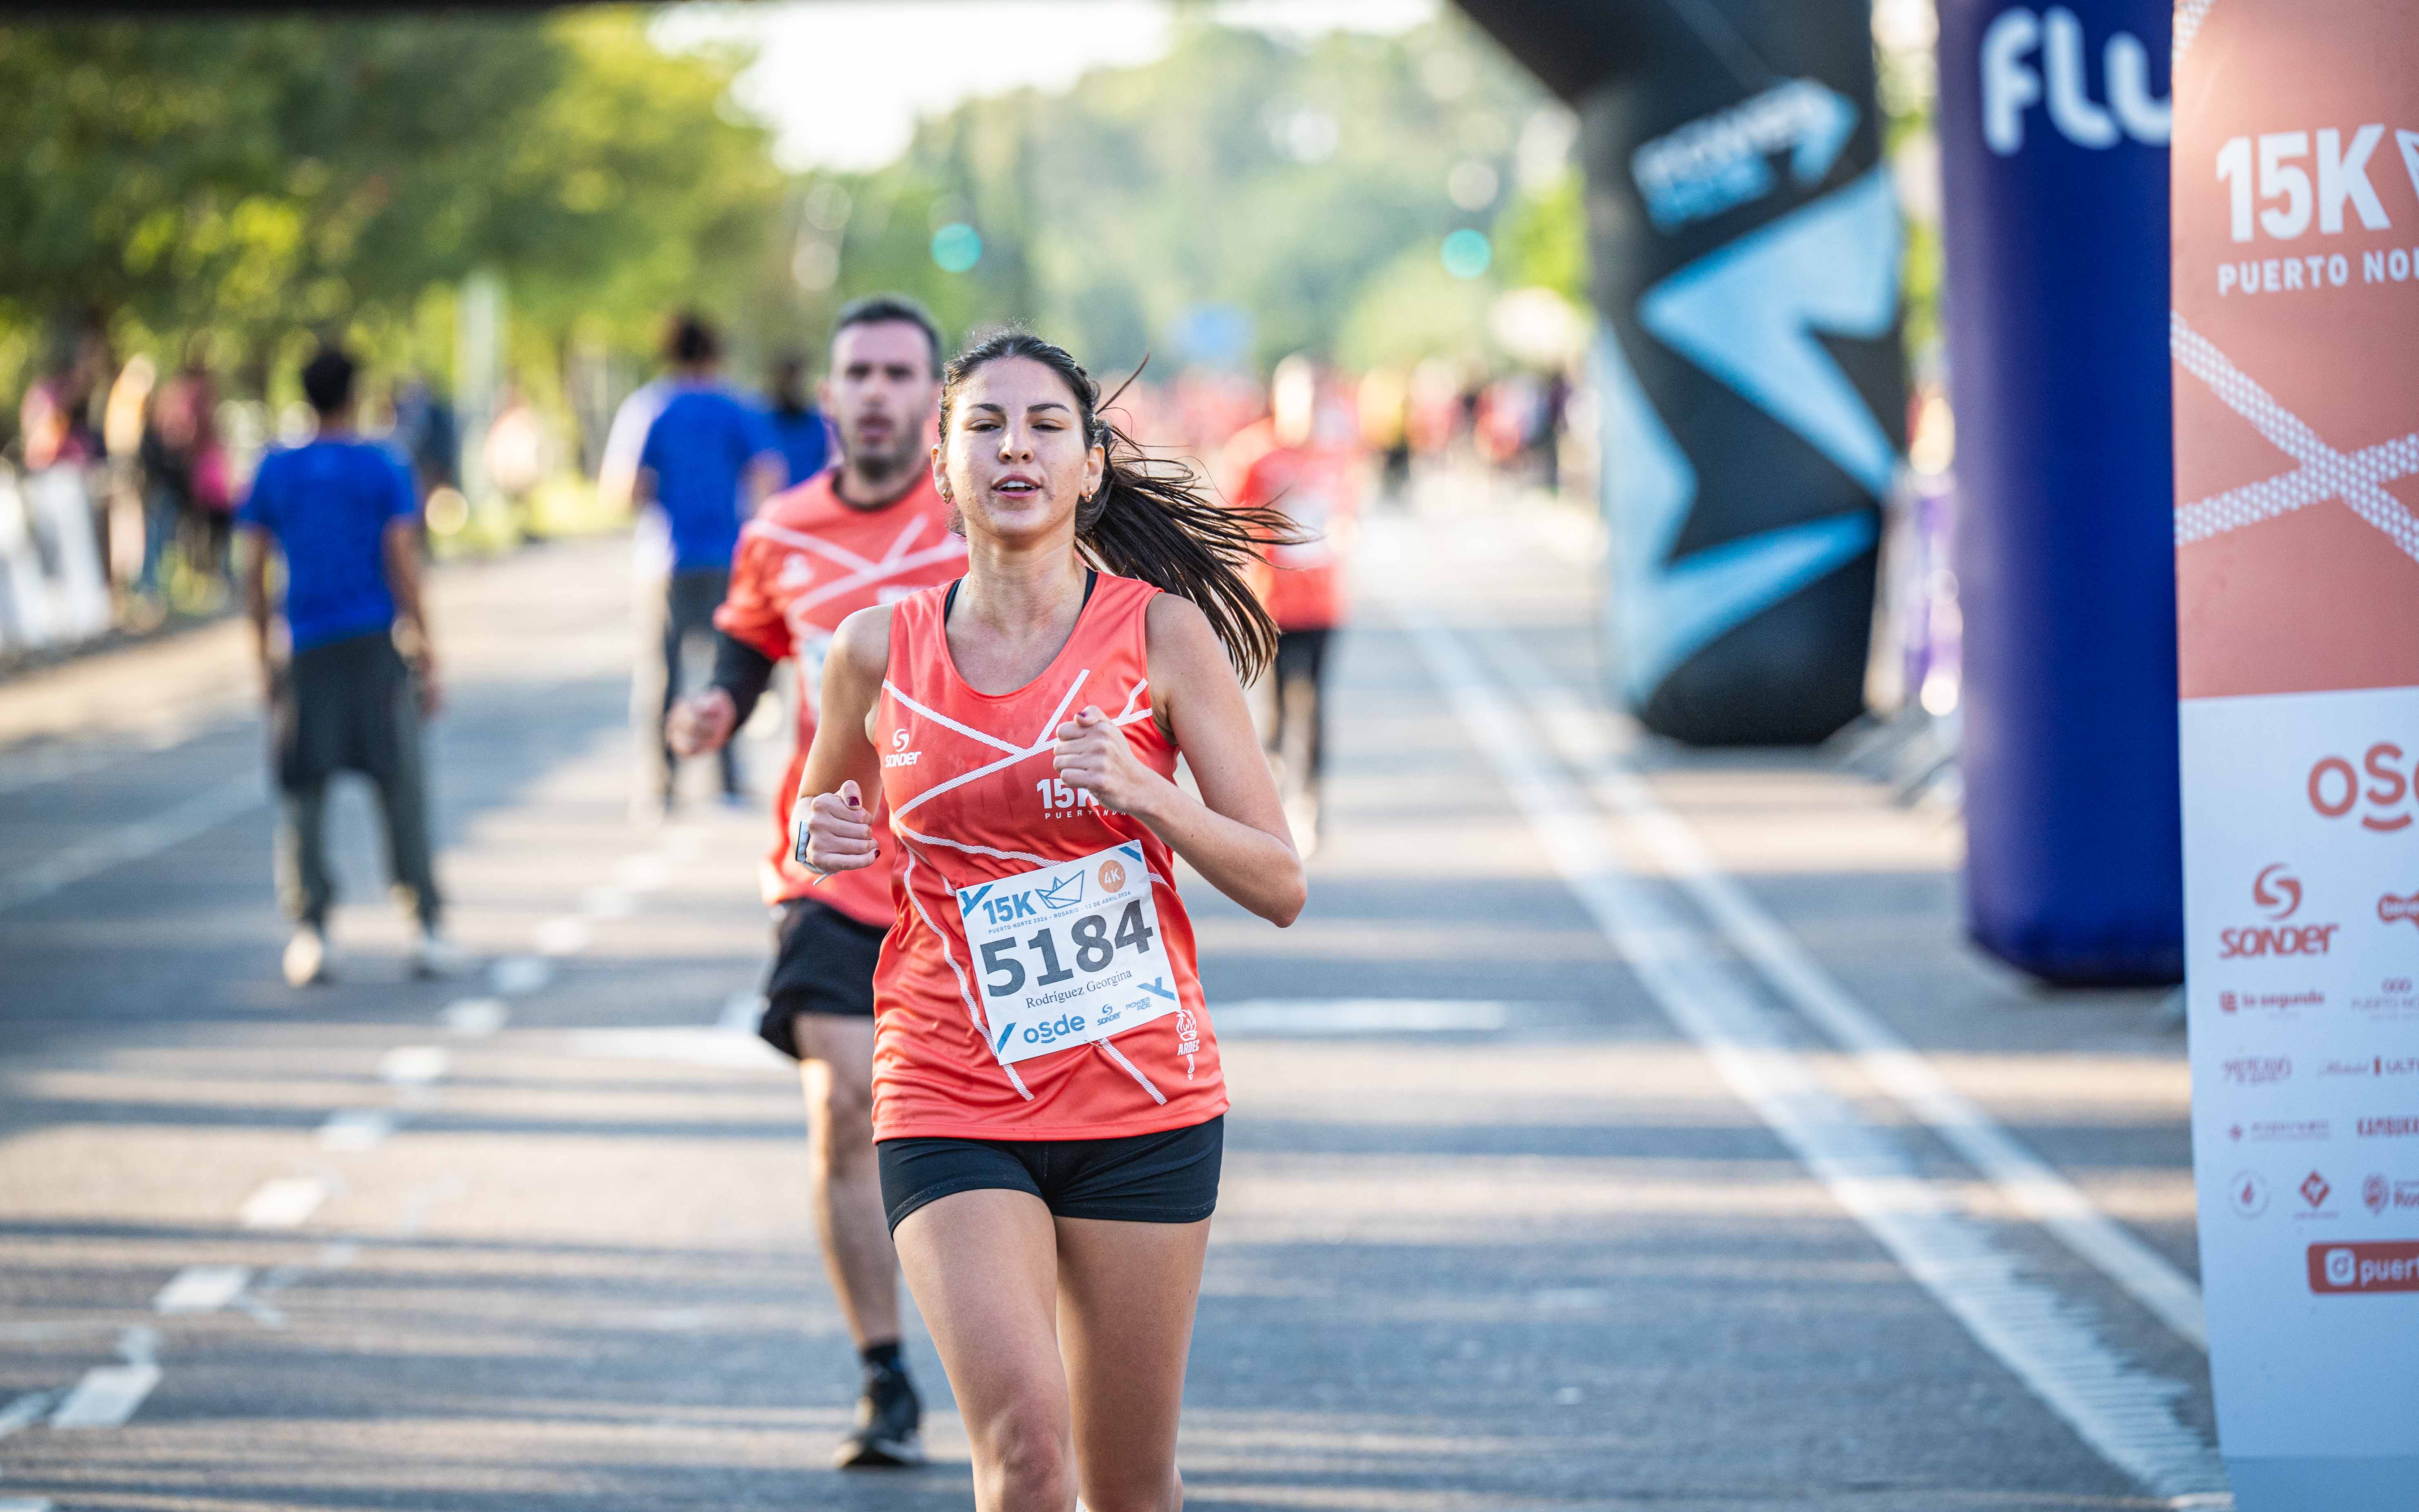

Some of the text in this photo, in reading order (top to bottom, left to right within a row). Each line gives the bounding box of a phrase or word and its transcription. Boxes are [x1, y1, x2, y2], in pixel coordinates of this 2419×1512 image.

[2216, 123, 2392, 243] 15K
[2217, 253, 2349, 297] PUERTO
[1104, 868, 1121, 884] 4K
[983, 891, 1037, 924] 15K
[988, 925, 1011, 934] PUERTO
[1102, 896, 1117, 904] ABRIL
[980, 899, 1153, 997] 5184
[1026, 970, 1132, 1008] Rodríguez Georgina
[1177, 1039, 1200, 1056] ARDEC
